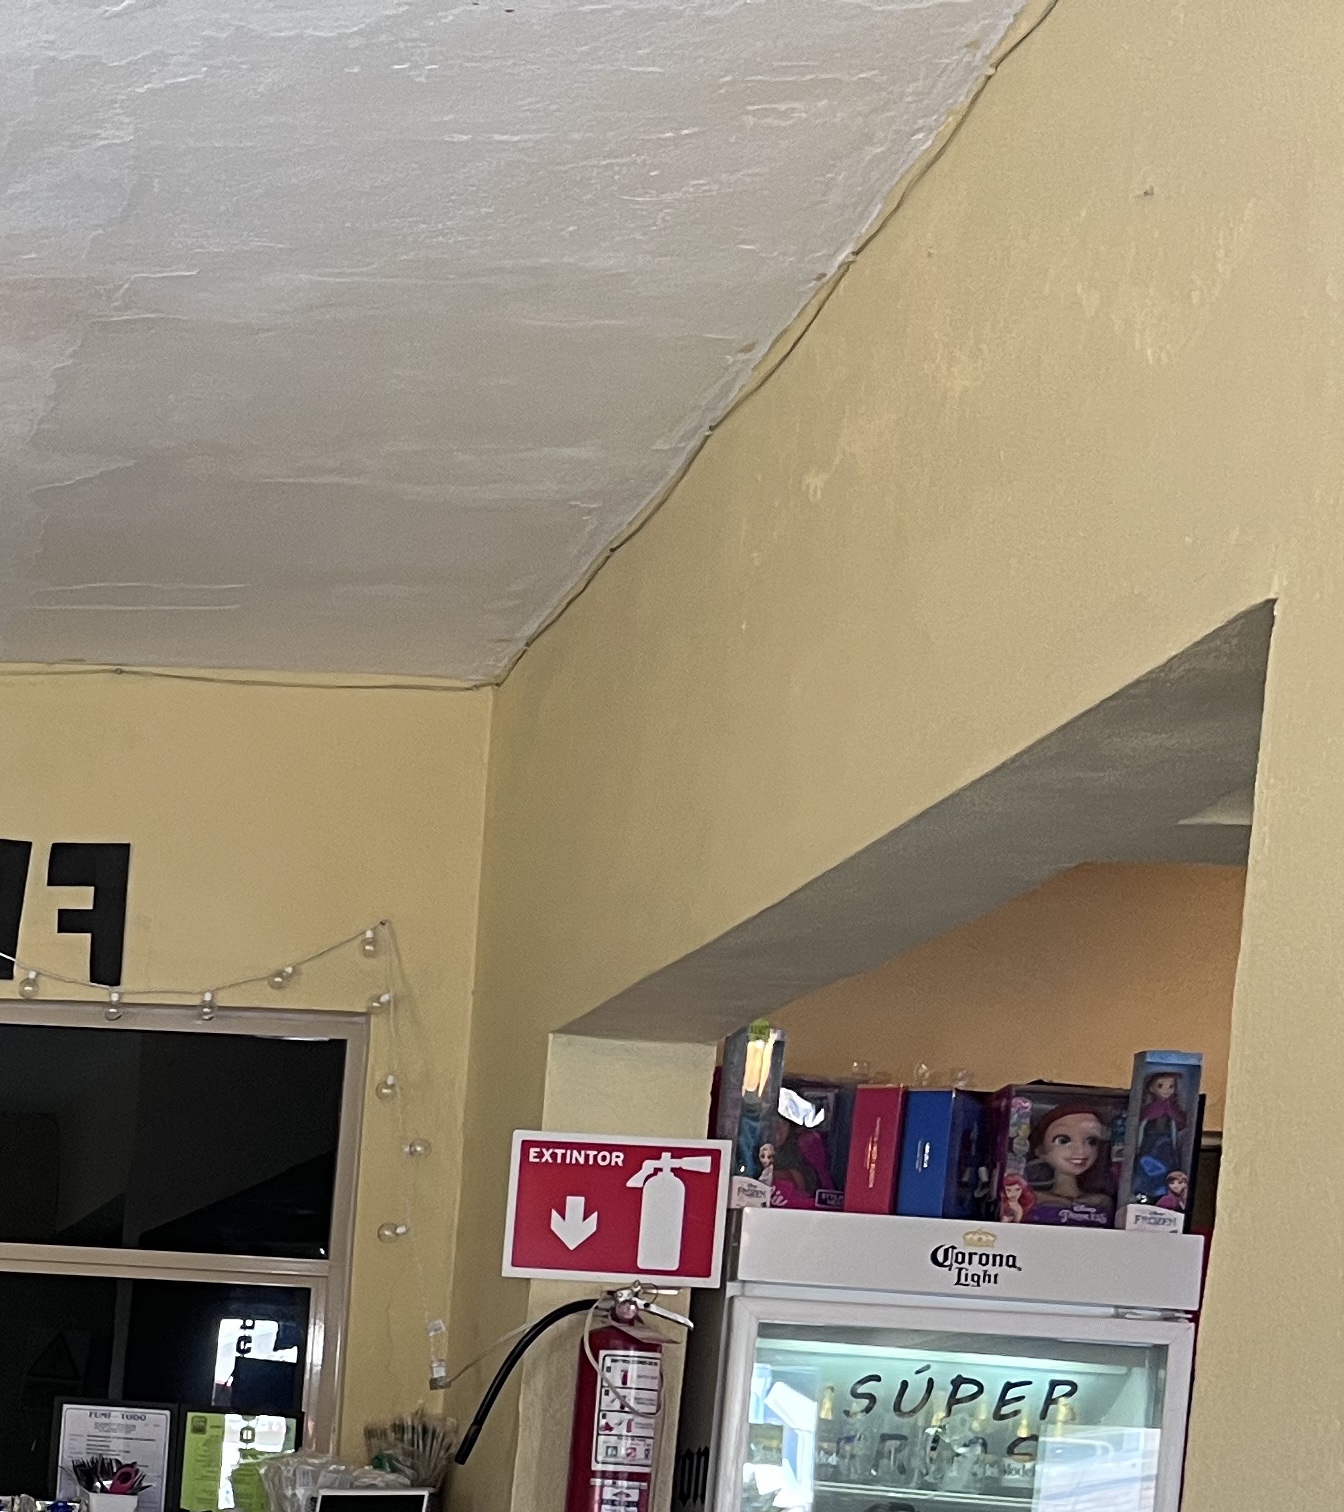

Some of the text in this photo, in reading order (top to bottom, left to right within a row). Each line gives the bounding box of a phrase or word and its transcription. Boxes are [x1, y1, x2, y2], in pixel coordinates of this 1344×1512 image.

[527, 1146, 626, 1169] EXTINTOR
[930, 1244, 1018, 1272] Corona
[954, 1267, 999, 1288] Light
[842, 1363, 1079, 1423] SÚPER
